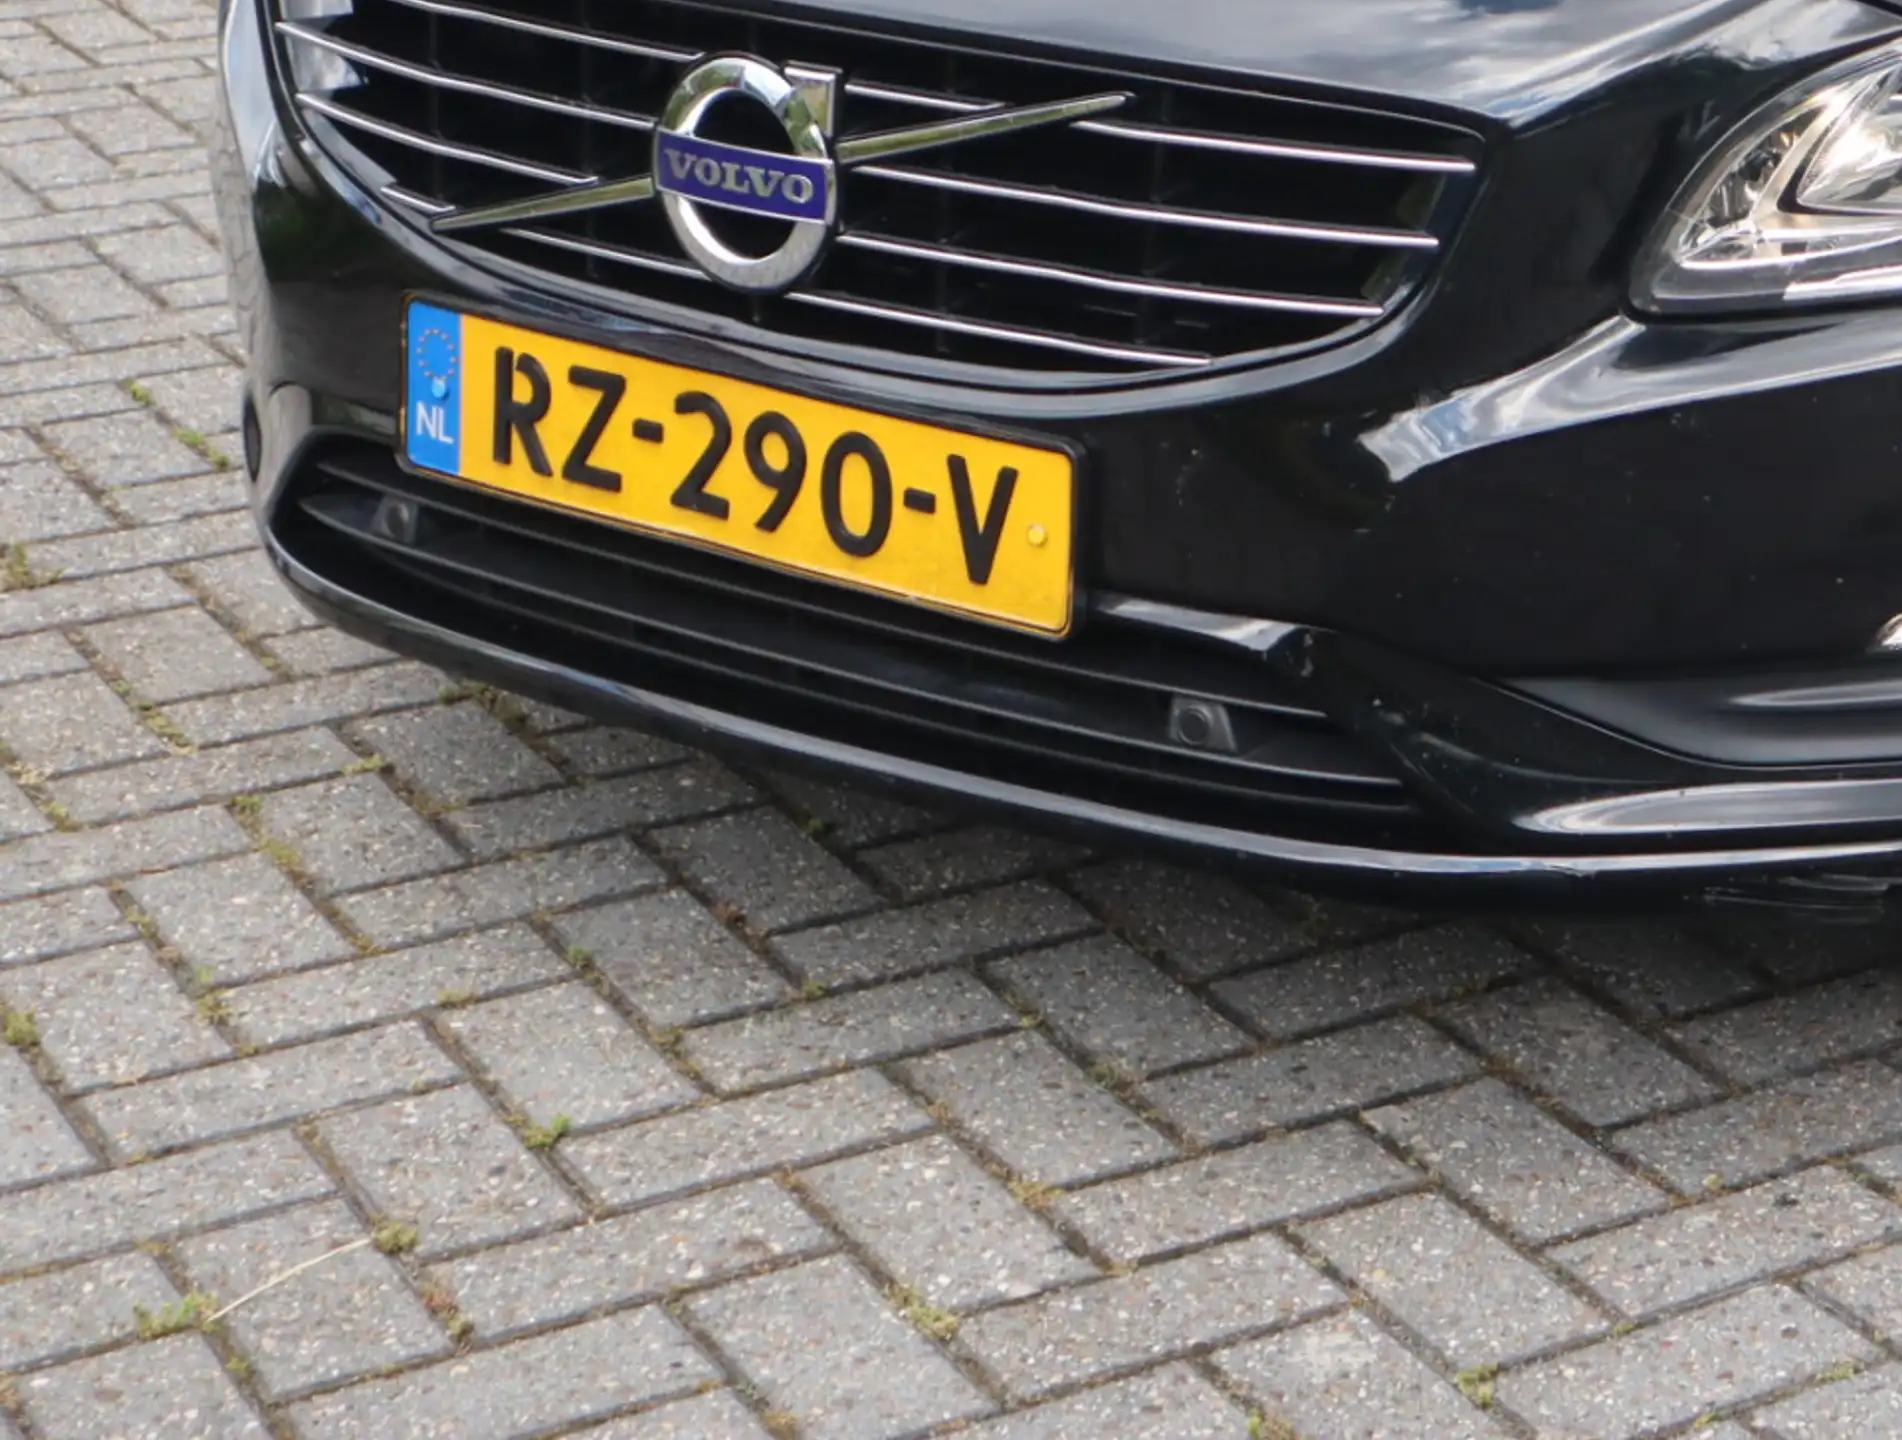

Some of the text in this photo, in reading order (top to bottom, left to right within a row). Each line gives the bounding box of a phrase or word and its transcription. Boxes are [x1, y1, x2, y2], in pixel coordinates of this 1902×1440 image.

[664, 148, 814, 205] VOLVO
[416, 400, 455, 445] NL
[492, 346, 1018, 586] RZ-290-V
